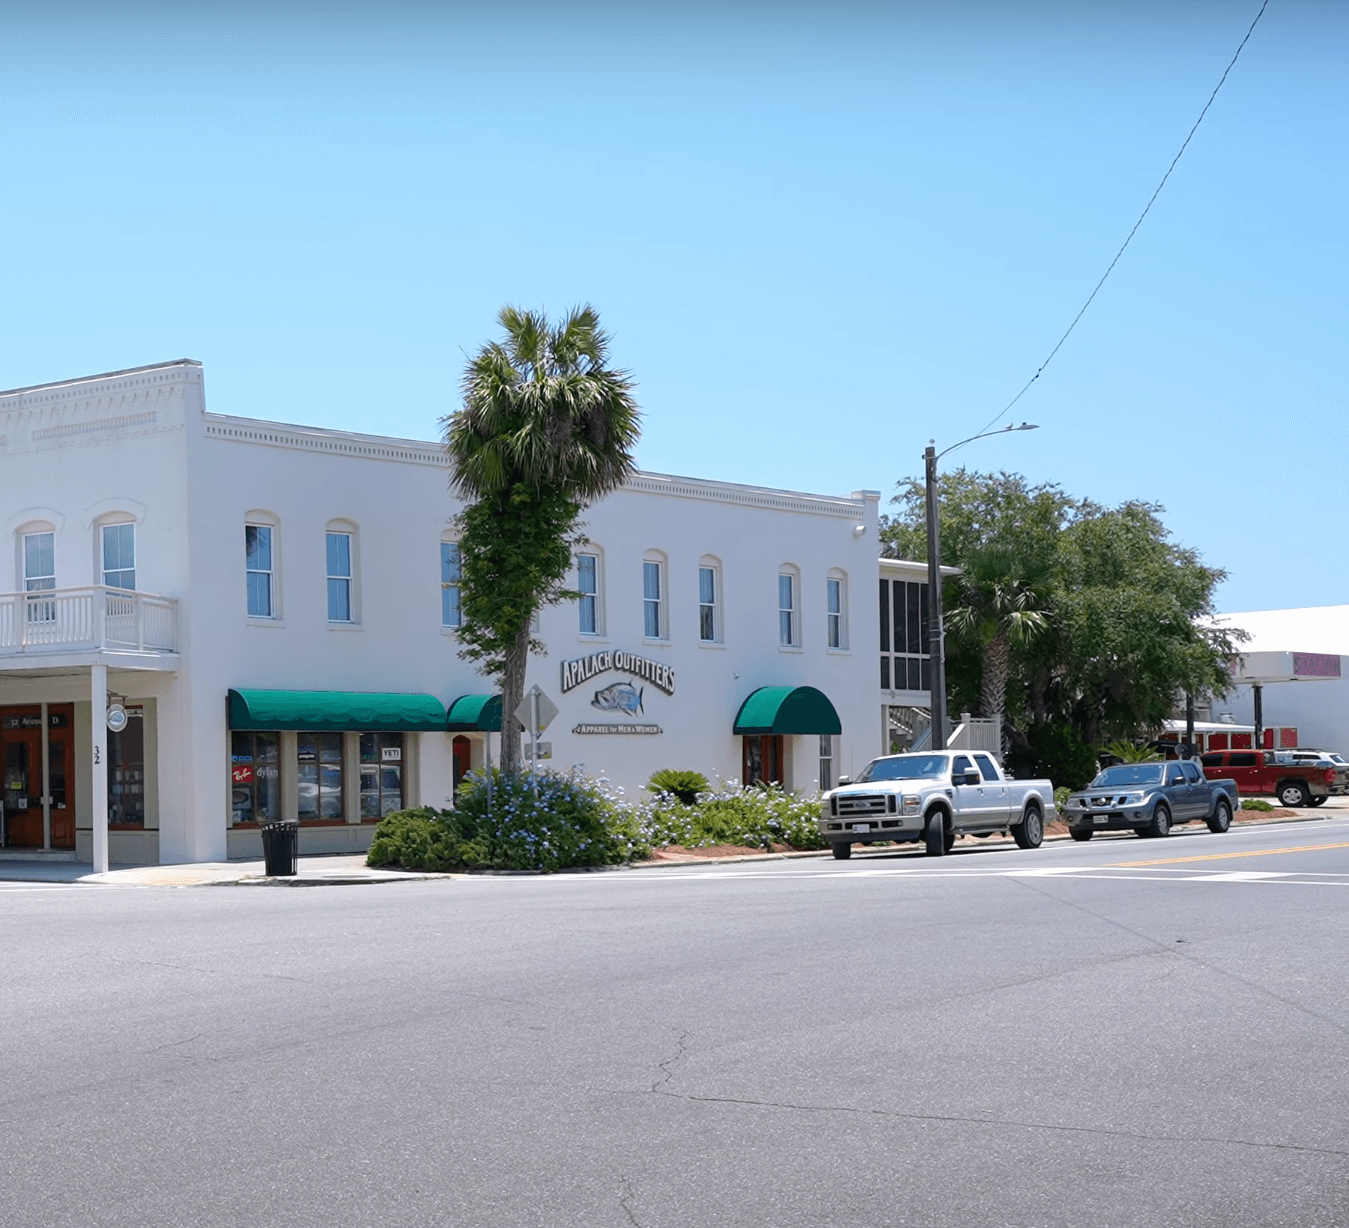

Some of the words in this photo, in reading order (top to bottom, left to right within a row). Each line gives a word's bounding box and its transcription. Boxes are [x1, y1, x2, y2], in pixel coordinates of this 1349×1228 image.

[561, 651, 612, 693] APALACH
[614, 650, 675, 695] OUTFITTERS
[581, 724, 609, 733] APPAREL
[618, 725, 631, 733] MEN
[636, 725, 657, 733] WOMEN
[94, 745, 100, 765] 32
[384, 750, 399, 758] YETI
[257, 767, 279, 778] dylan
